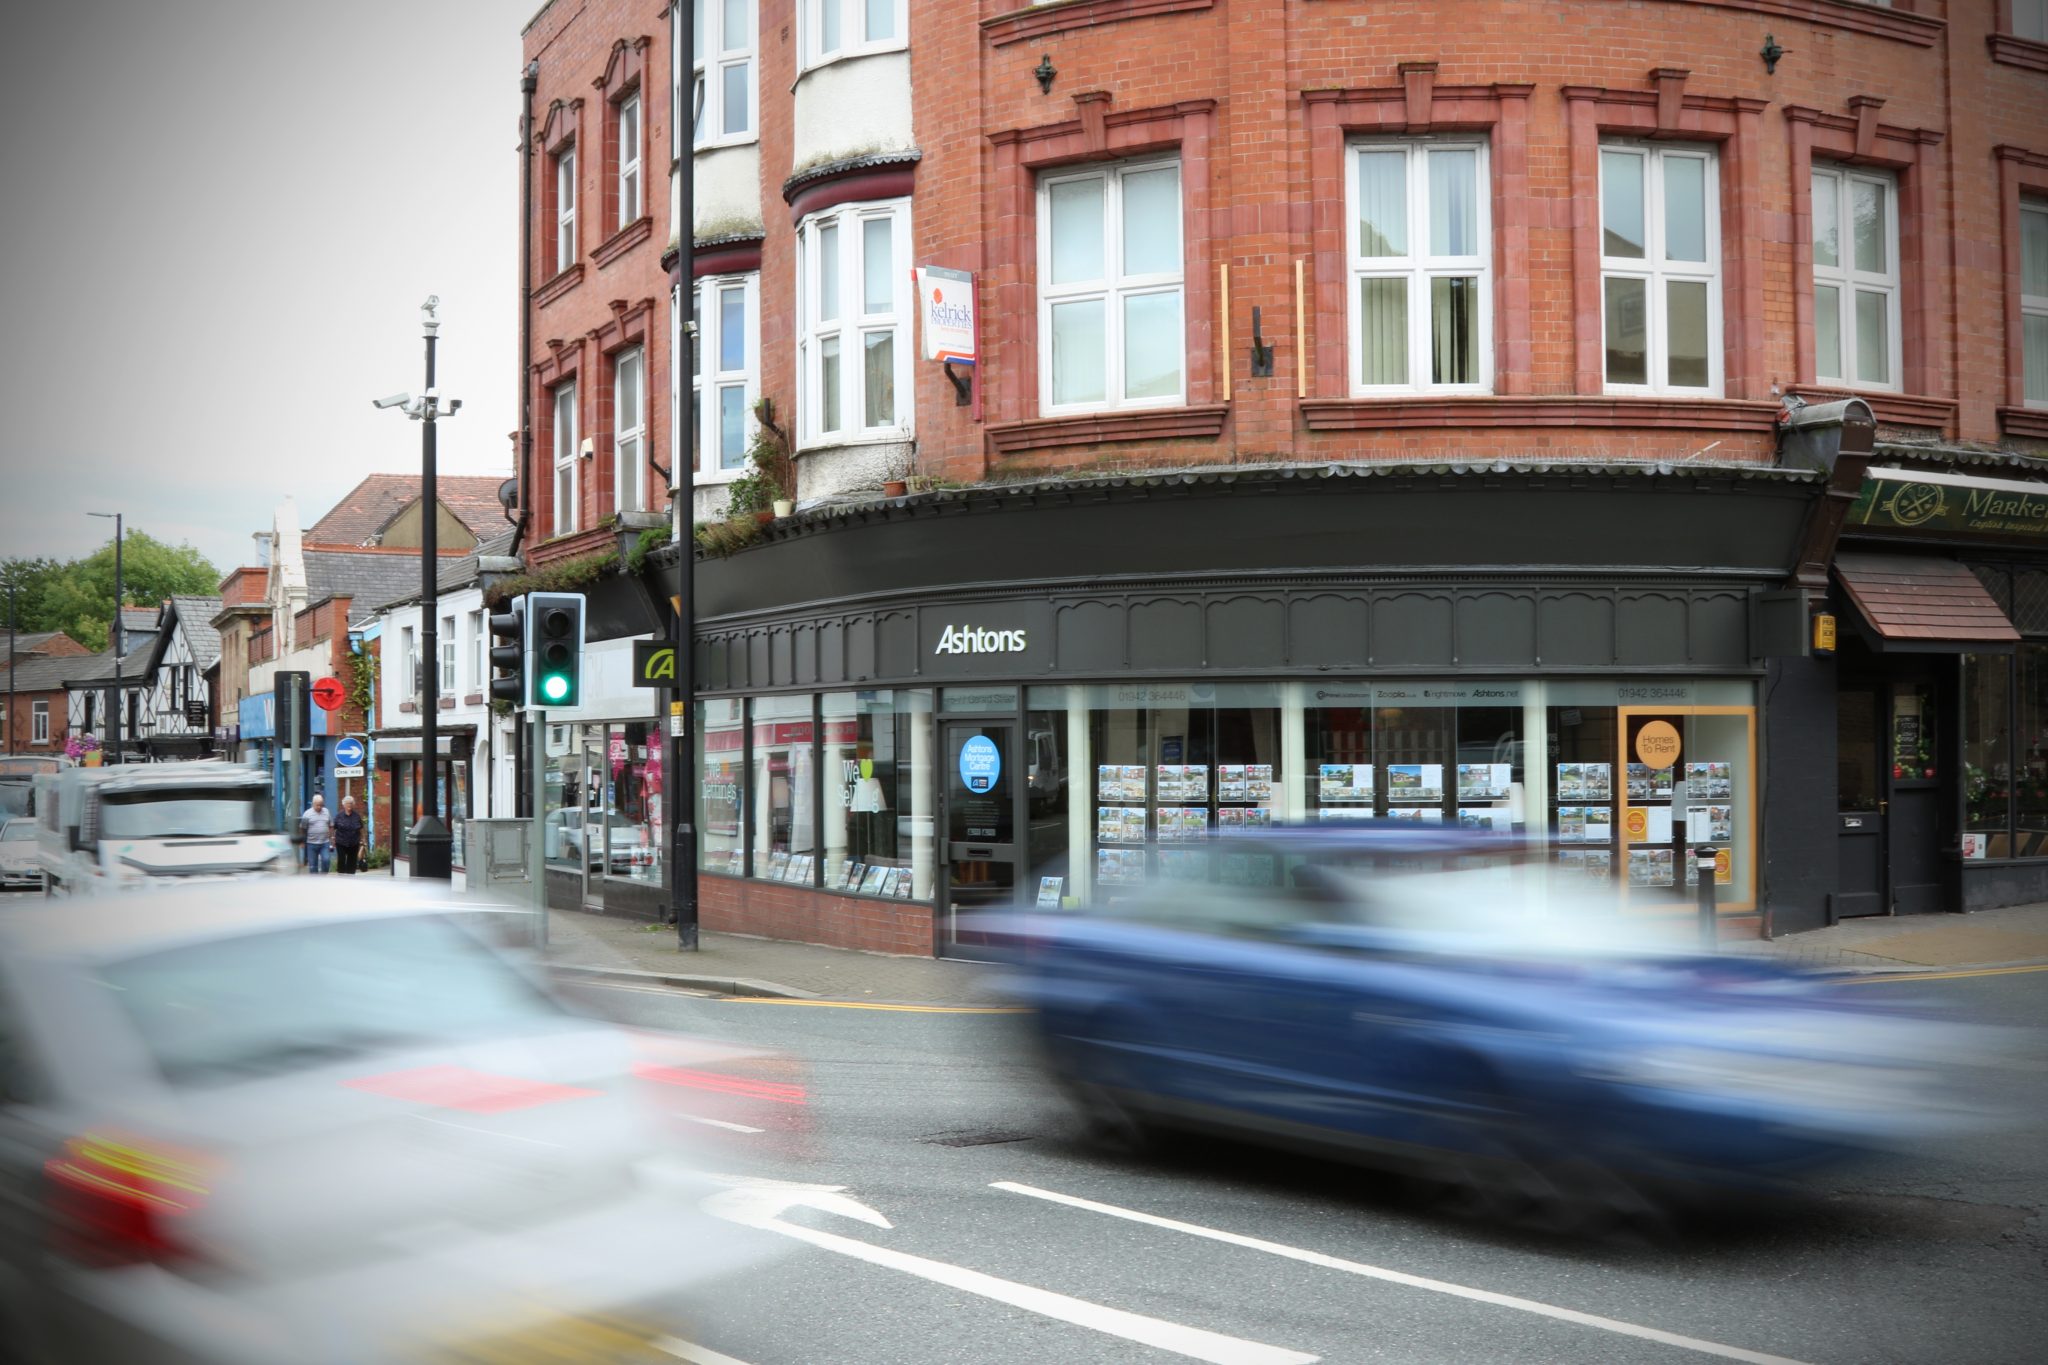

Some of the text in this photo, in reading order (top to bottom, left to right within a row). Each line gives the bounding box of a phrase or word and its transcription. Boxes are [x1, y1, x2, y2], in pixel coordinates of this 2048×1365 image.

[931, 300, 972, 321] kelrick
[1961, 488, 2048, 518] Marke
[935, 624, 1027, 655] Ashtons
[1119, 691, 1146, 701] 01942
[1619, 688, 1687, 698] 01942 364446
[1643, 735, 1675, 744] Homes
[967, 744, 993, 753] Ashtons
[1641, 744, 1675, 753] To Rent
[964, 753, 995, 764] Mortgage
[970, 761, 991, 770] Centre
[842, 760, 860, 783] We
[838, 784, 880, 813] Sellg
